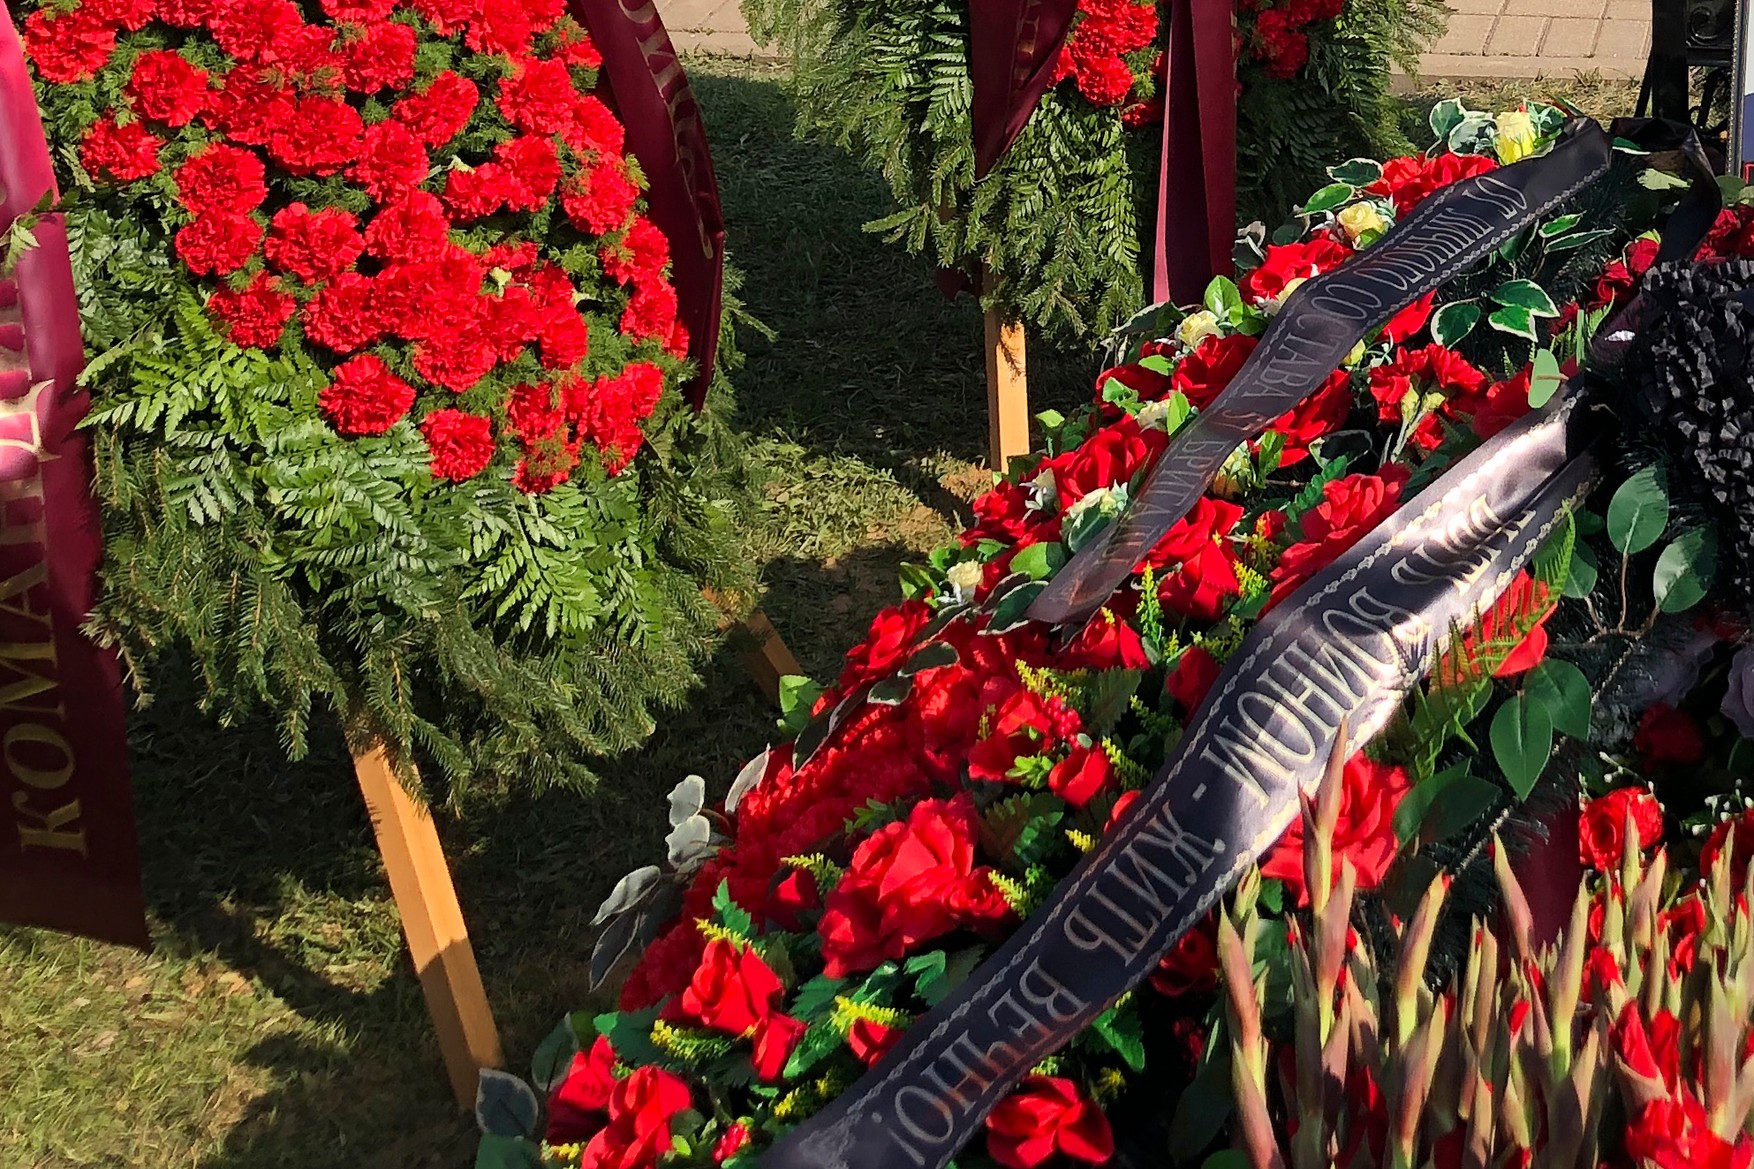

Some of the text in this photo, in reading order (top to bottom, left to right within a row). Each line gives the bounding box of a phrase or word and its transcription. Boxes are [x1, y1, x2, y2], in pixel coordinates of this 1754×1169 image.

[1352, 207, 1496, 291] ЛИЧНОГО
[1461, 175, 1528, 220] ОТ
[1240, 283, 1383, 398] СОСТАВА
[1199, 586, 1430, 810] ВОИНОМ
[1064, 799, 1227, 967] ЖИТЬ
[870, 955, 1092, 1167] ВЕЧНО!
